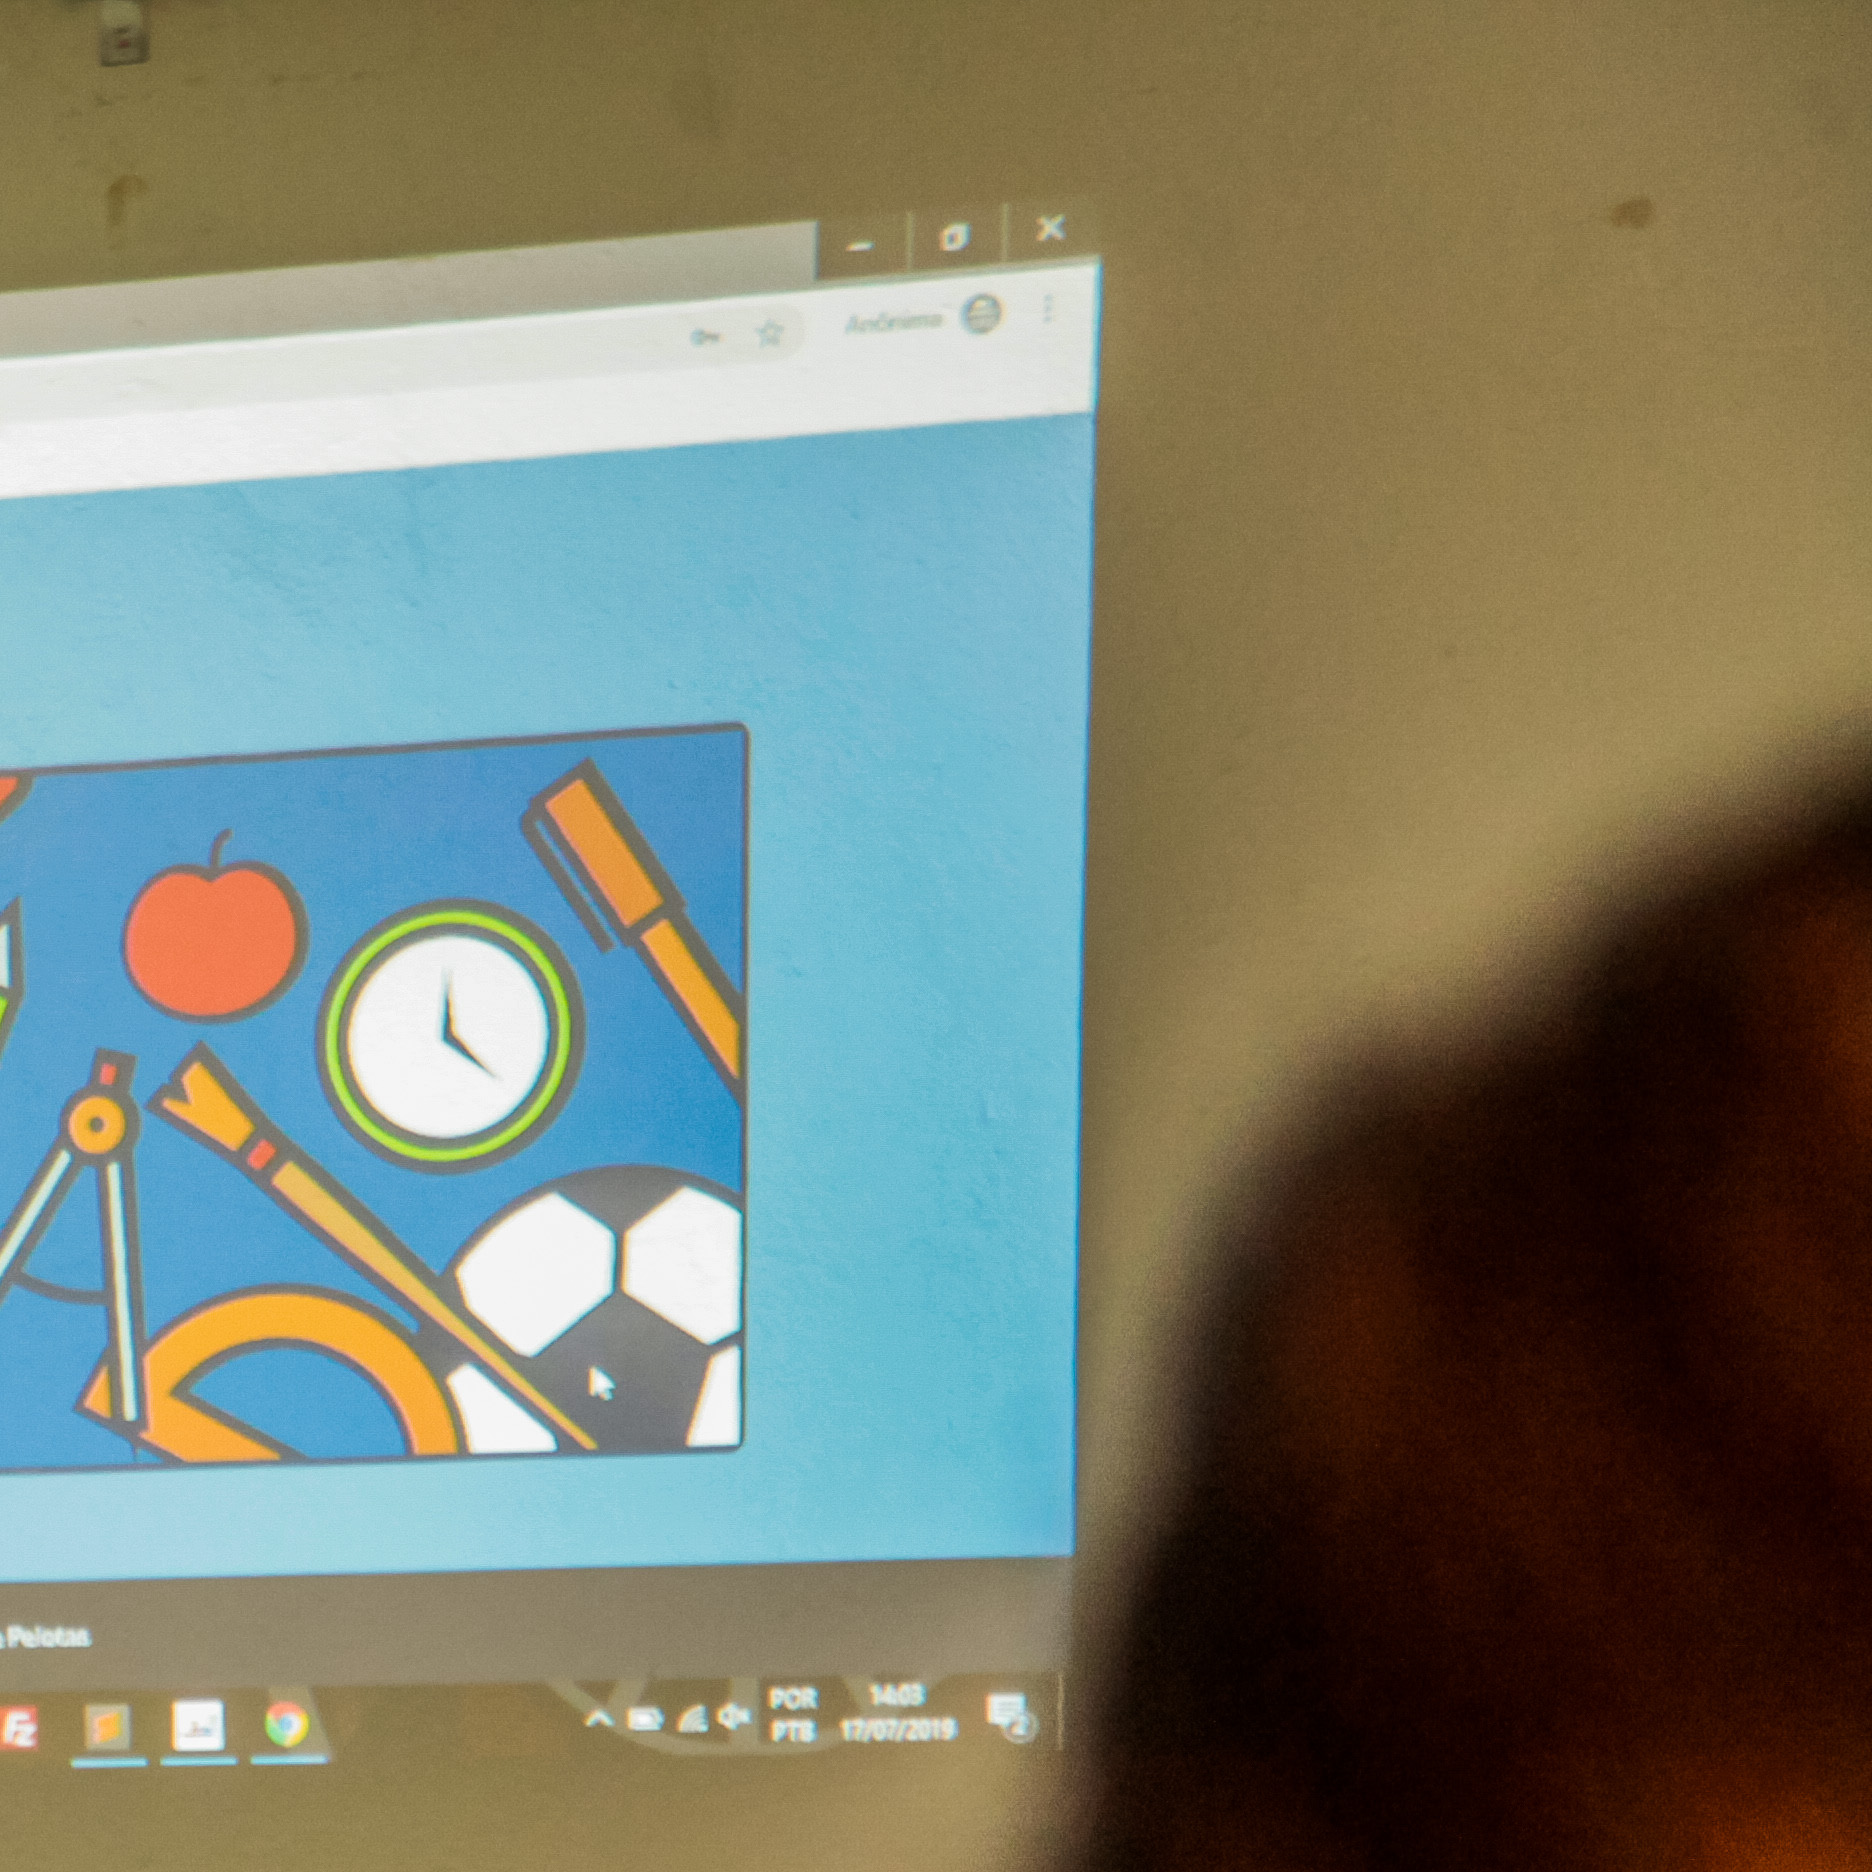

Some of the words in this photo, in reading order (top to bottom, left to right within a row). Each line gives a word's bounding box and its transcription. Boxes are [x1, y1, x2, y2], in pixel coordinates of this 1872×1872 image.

[6, 1626, 93, 1651] Pelotas
[769, 1686, 818, 1711] POR
[771, 1718, 817, 1744] PTB
